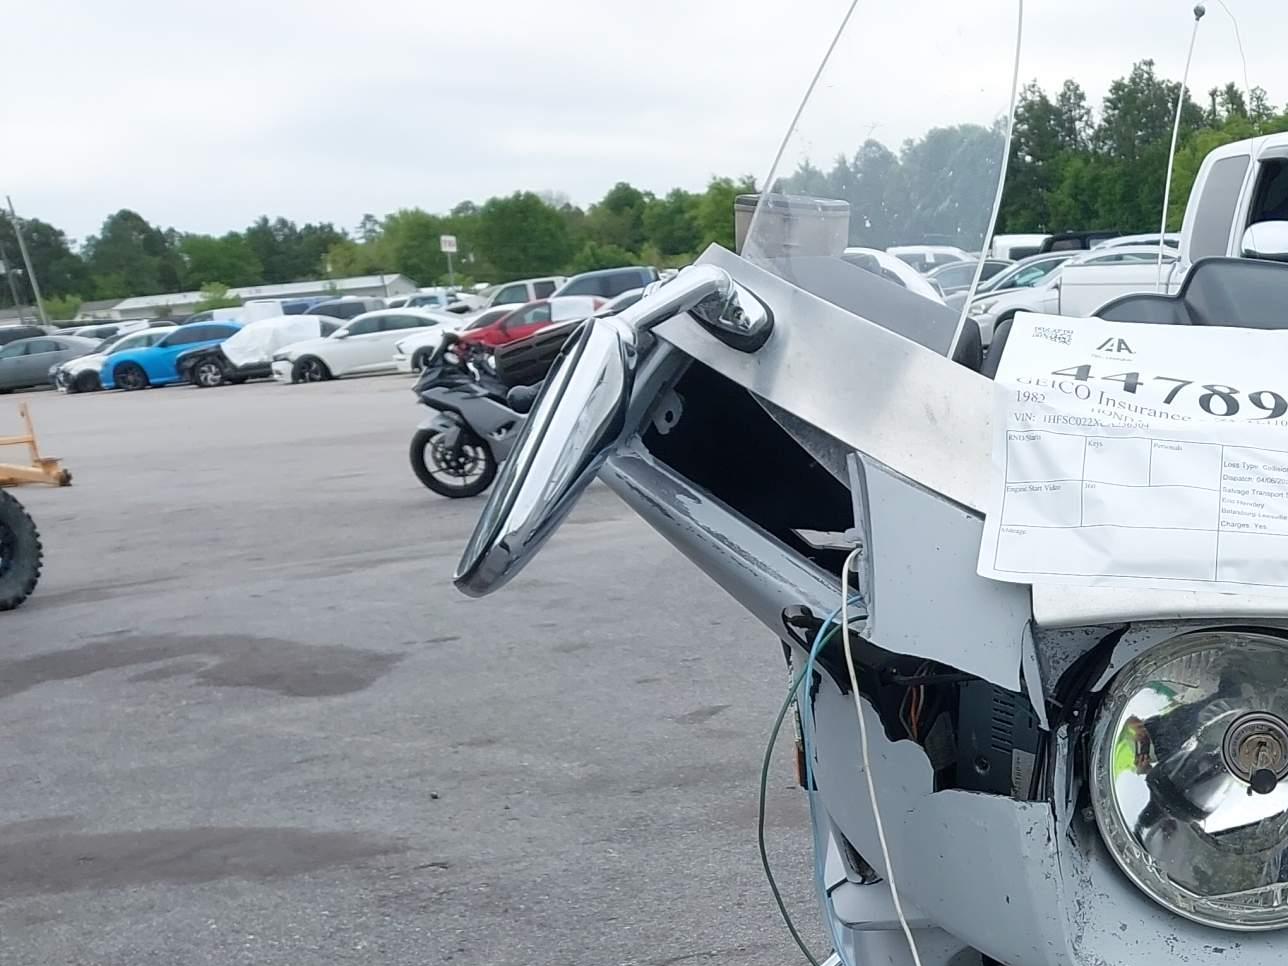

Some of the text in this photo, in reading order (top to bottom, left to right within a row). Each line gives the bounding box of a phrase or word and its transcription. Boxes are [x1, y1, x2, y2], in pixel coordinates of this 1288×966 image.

[1098, 390, 1193, 421] Insurance
[1014, 412, 1036, 422] VIN:
[1088, 440, 1104, 448] Keys
[1223, 461, 1240, 469] Loss
[1252, 488, 1284, 498] Transport
